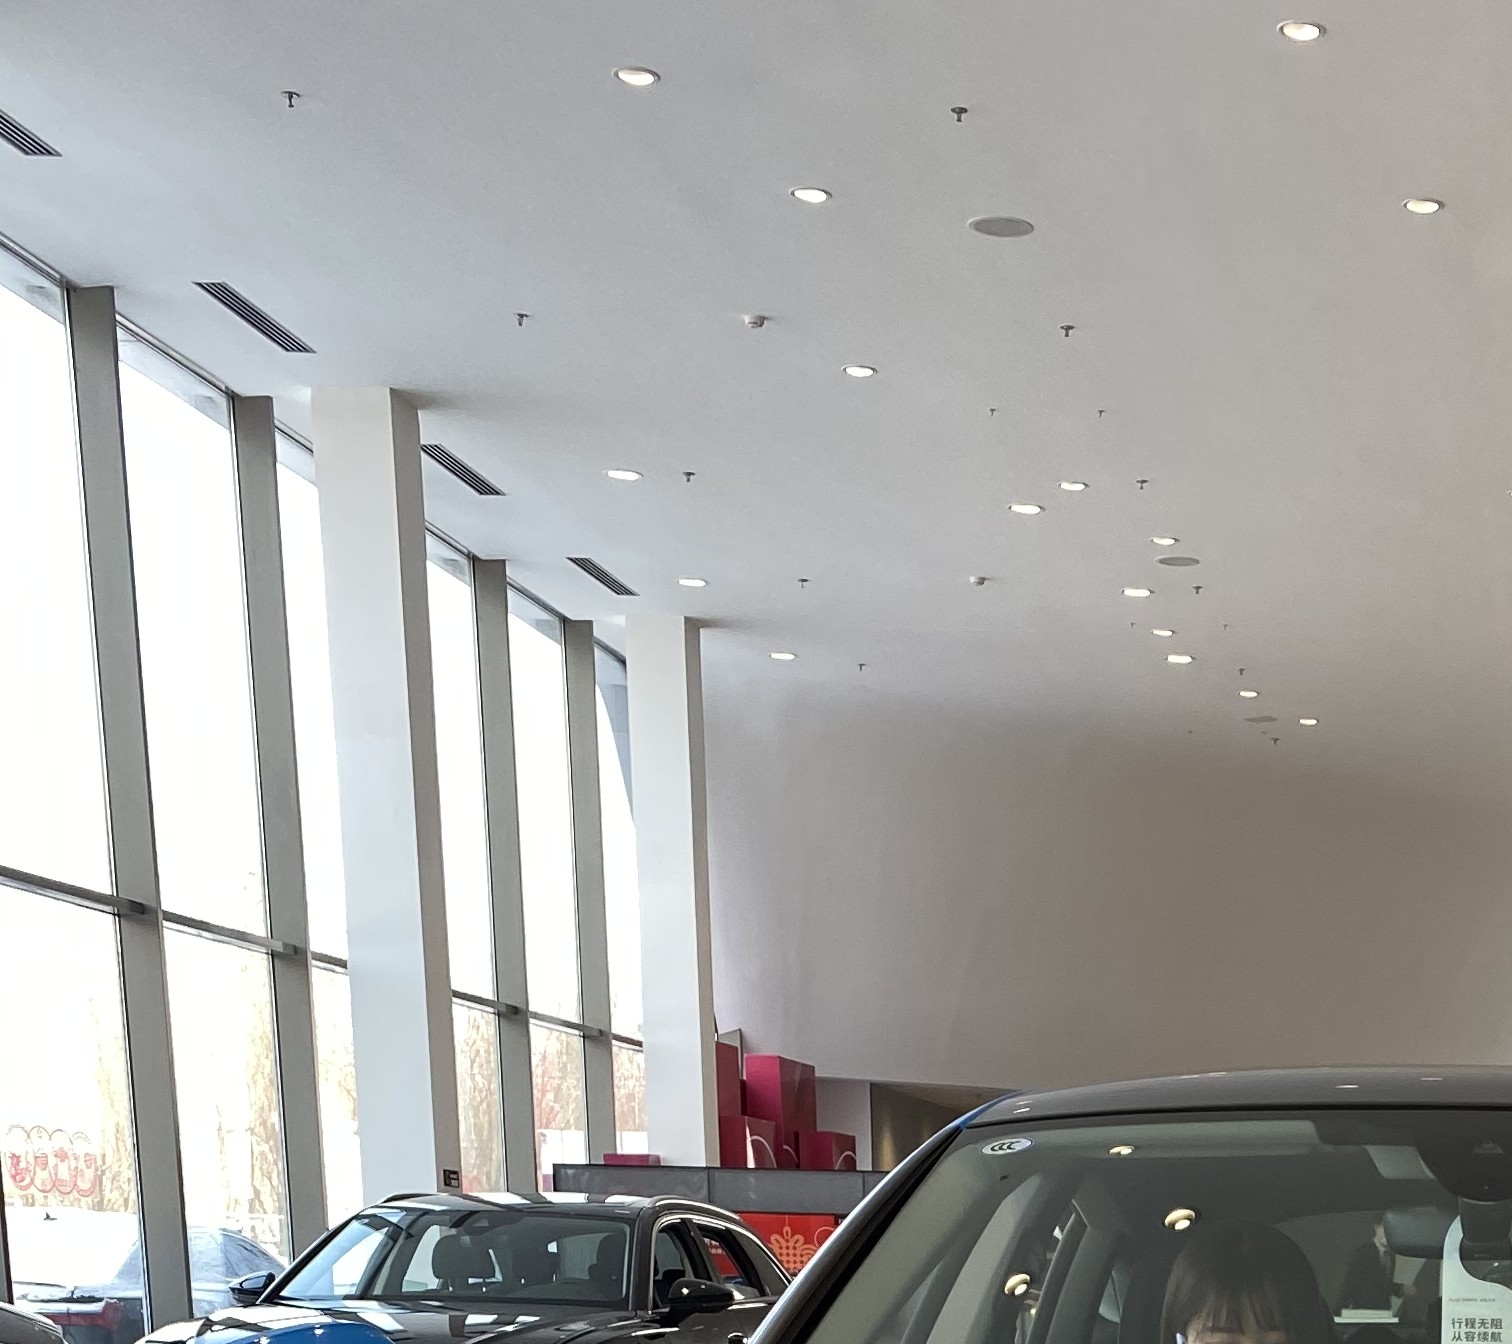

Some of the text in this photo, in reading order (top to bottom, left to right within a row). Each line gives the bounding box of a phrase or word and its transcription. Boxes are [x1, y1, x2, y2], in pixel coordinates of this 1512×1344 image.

[1451, 1317, 1503, 1330] 行程无阻
[1451, 1331, 1503, 1343] 从容续航
